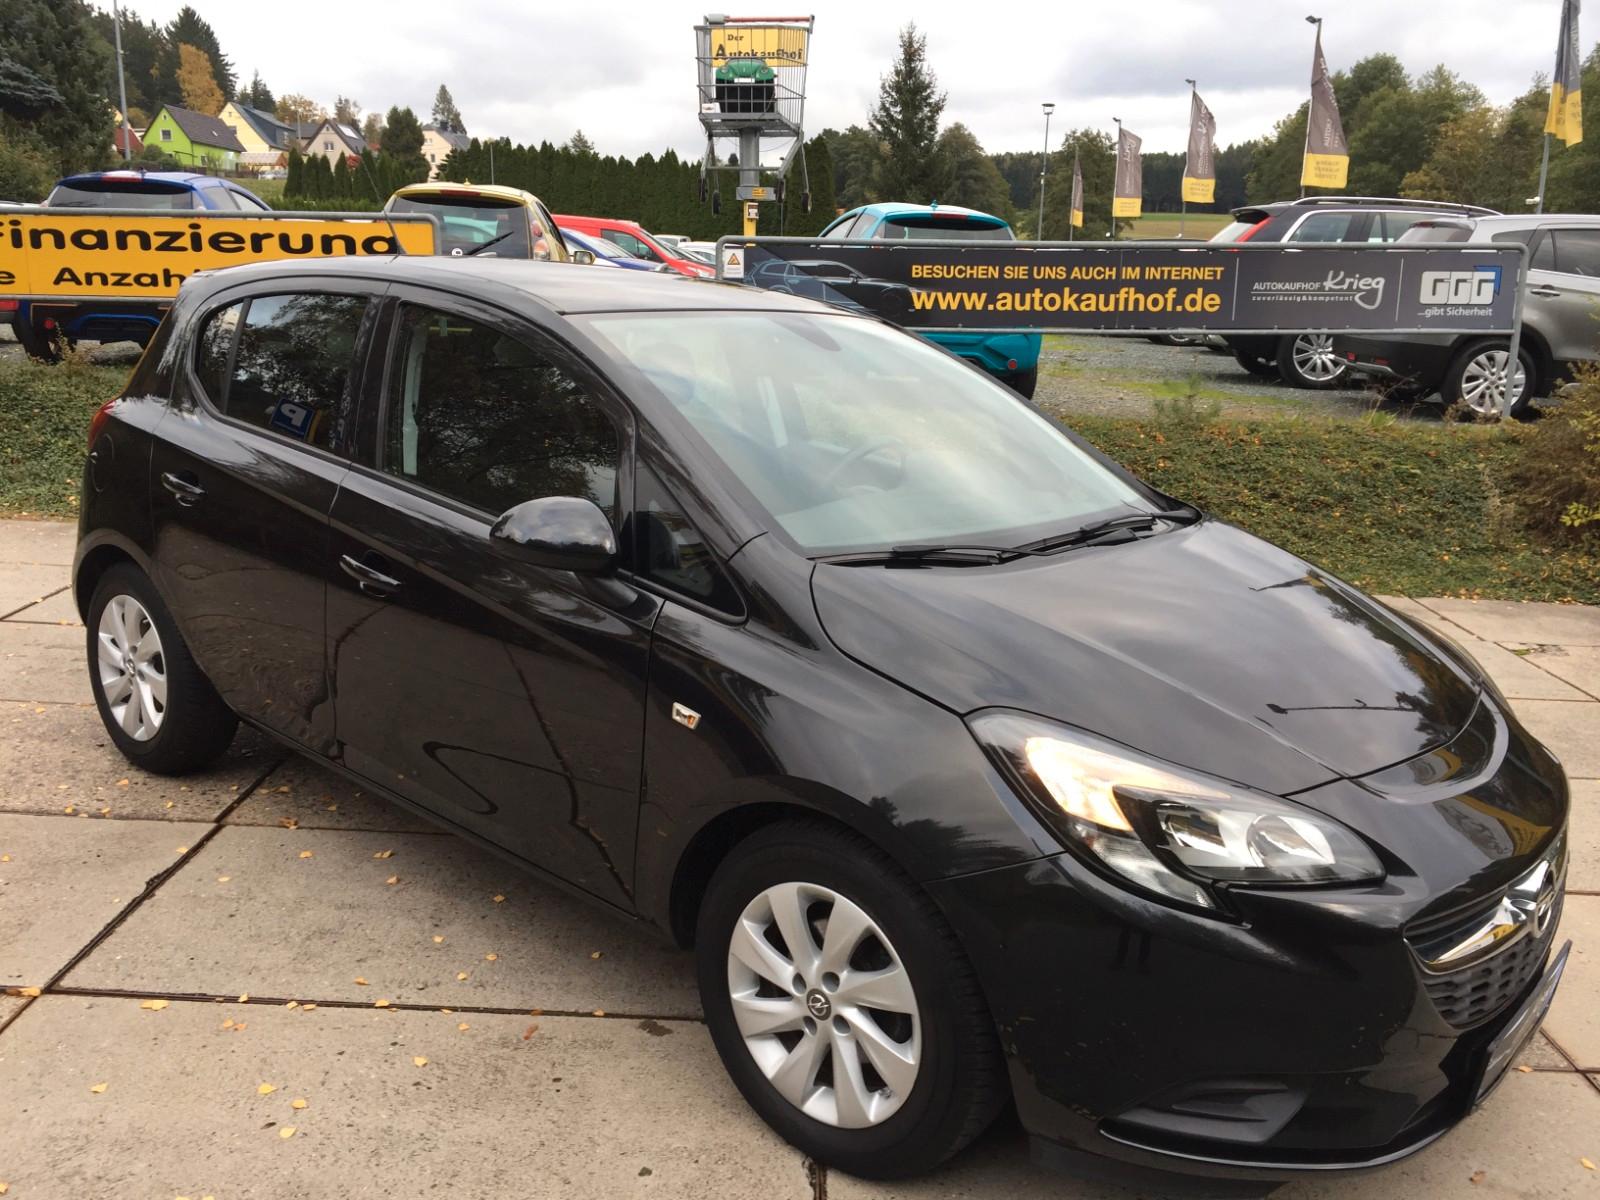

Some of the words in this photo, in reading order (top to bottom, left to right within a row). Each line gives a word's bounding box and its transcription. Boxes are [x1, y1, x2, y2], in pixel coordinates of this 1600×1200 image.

[714, 43, 803, 60] Autokaufhof
[53, 267, 200, 288] Anzah
[912, 265, 999, 278] BESUCHEN
[1003, 265, 1028, 279] SIE
[1033, 266, 1066, 279] UNS
[1070, 266, 1116, 280] AUCH
[1121, 266, 1140, 280] IM
[1145, 267, 1224, 280] INTERNET
[1253, 282, 1321, 290] AUTOKAUFHOF
[1323, 270, 1385, 310] Krieg
[1420, 271, 1496, 304] GGG
[912, 287, 1221, 312] www.autokaufhof.de
[1446, 307, 1493, 316] Sicherheit
